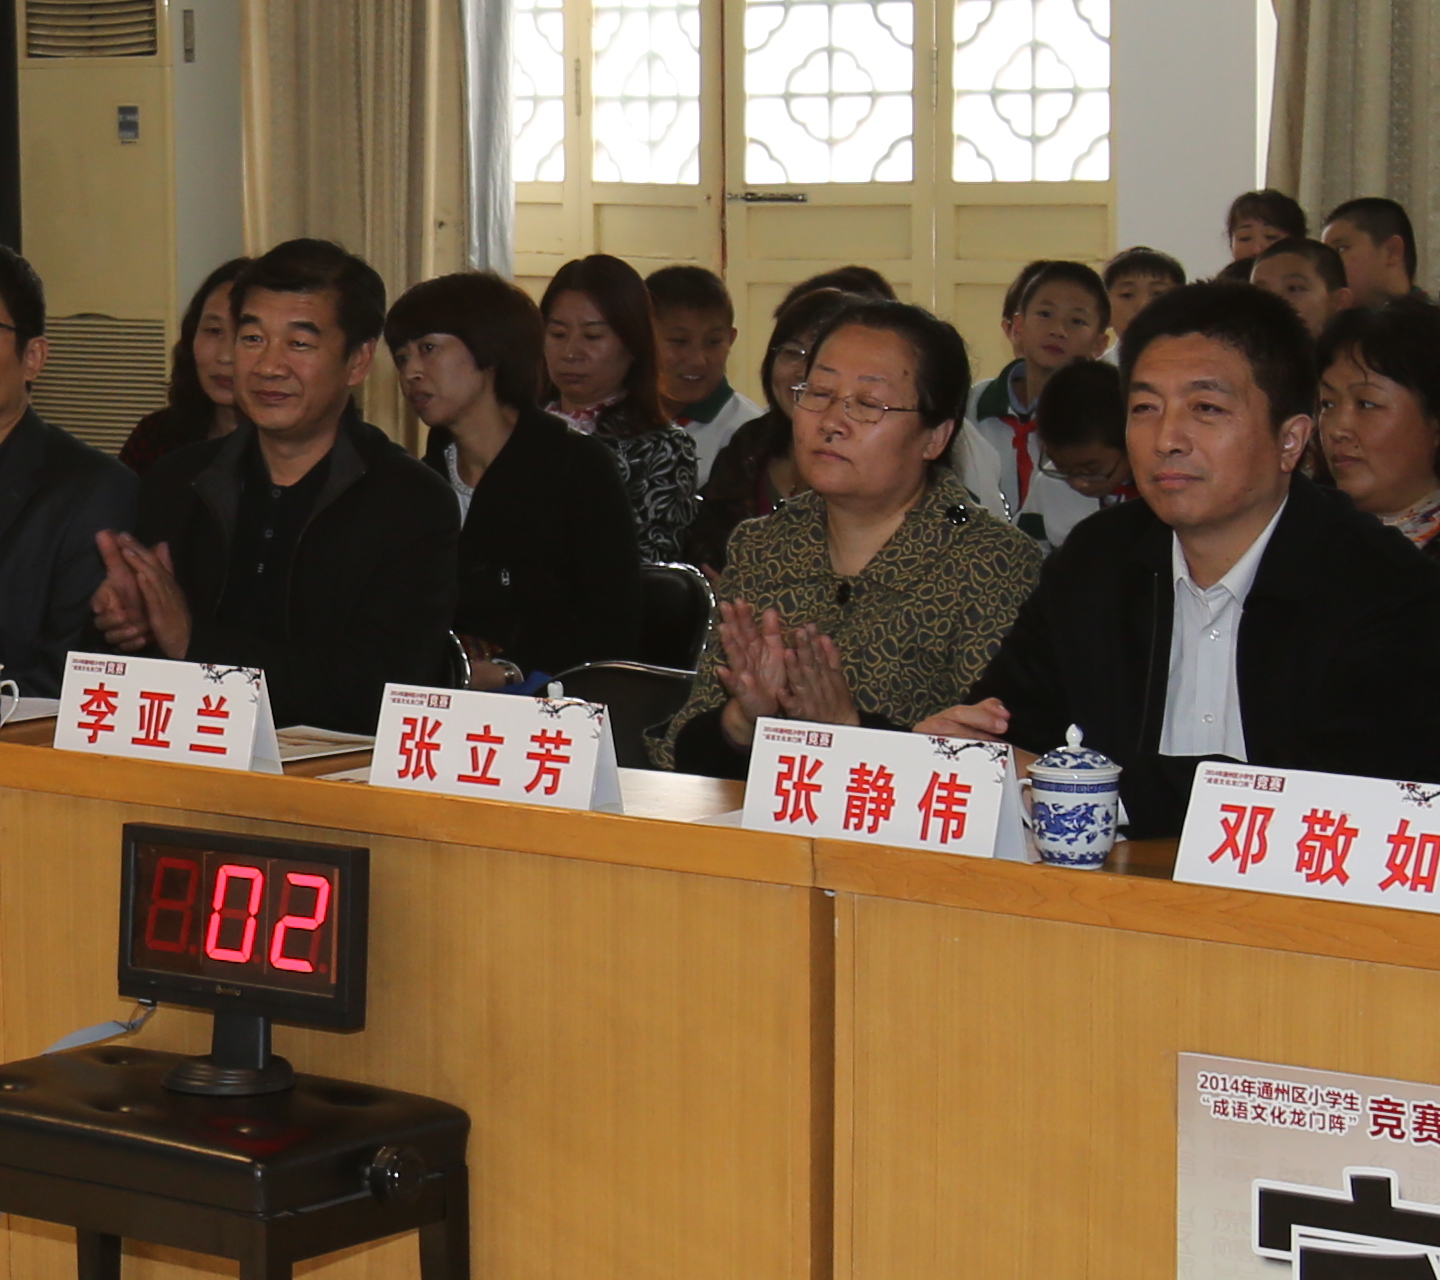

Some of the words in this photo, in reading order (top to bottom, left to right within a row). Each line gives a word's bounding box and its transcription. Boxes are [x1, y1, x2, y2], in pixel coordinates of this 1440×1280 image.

[77, 682, 230, 755] 李亚兰
[397, 715, 573, 796] 张立芳
[772, 754, 973, 844] 张静伟
[204, 863, 332, 974] 02
[1199, 1074, 1360, 1111] 2014年通州区小学生
